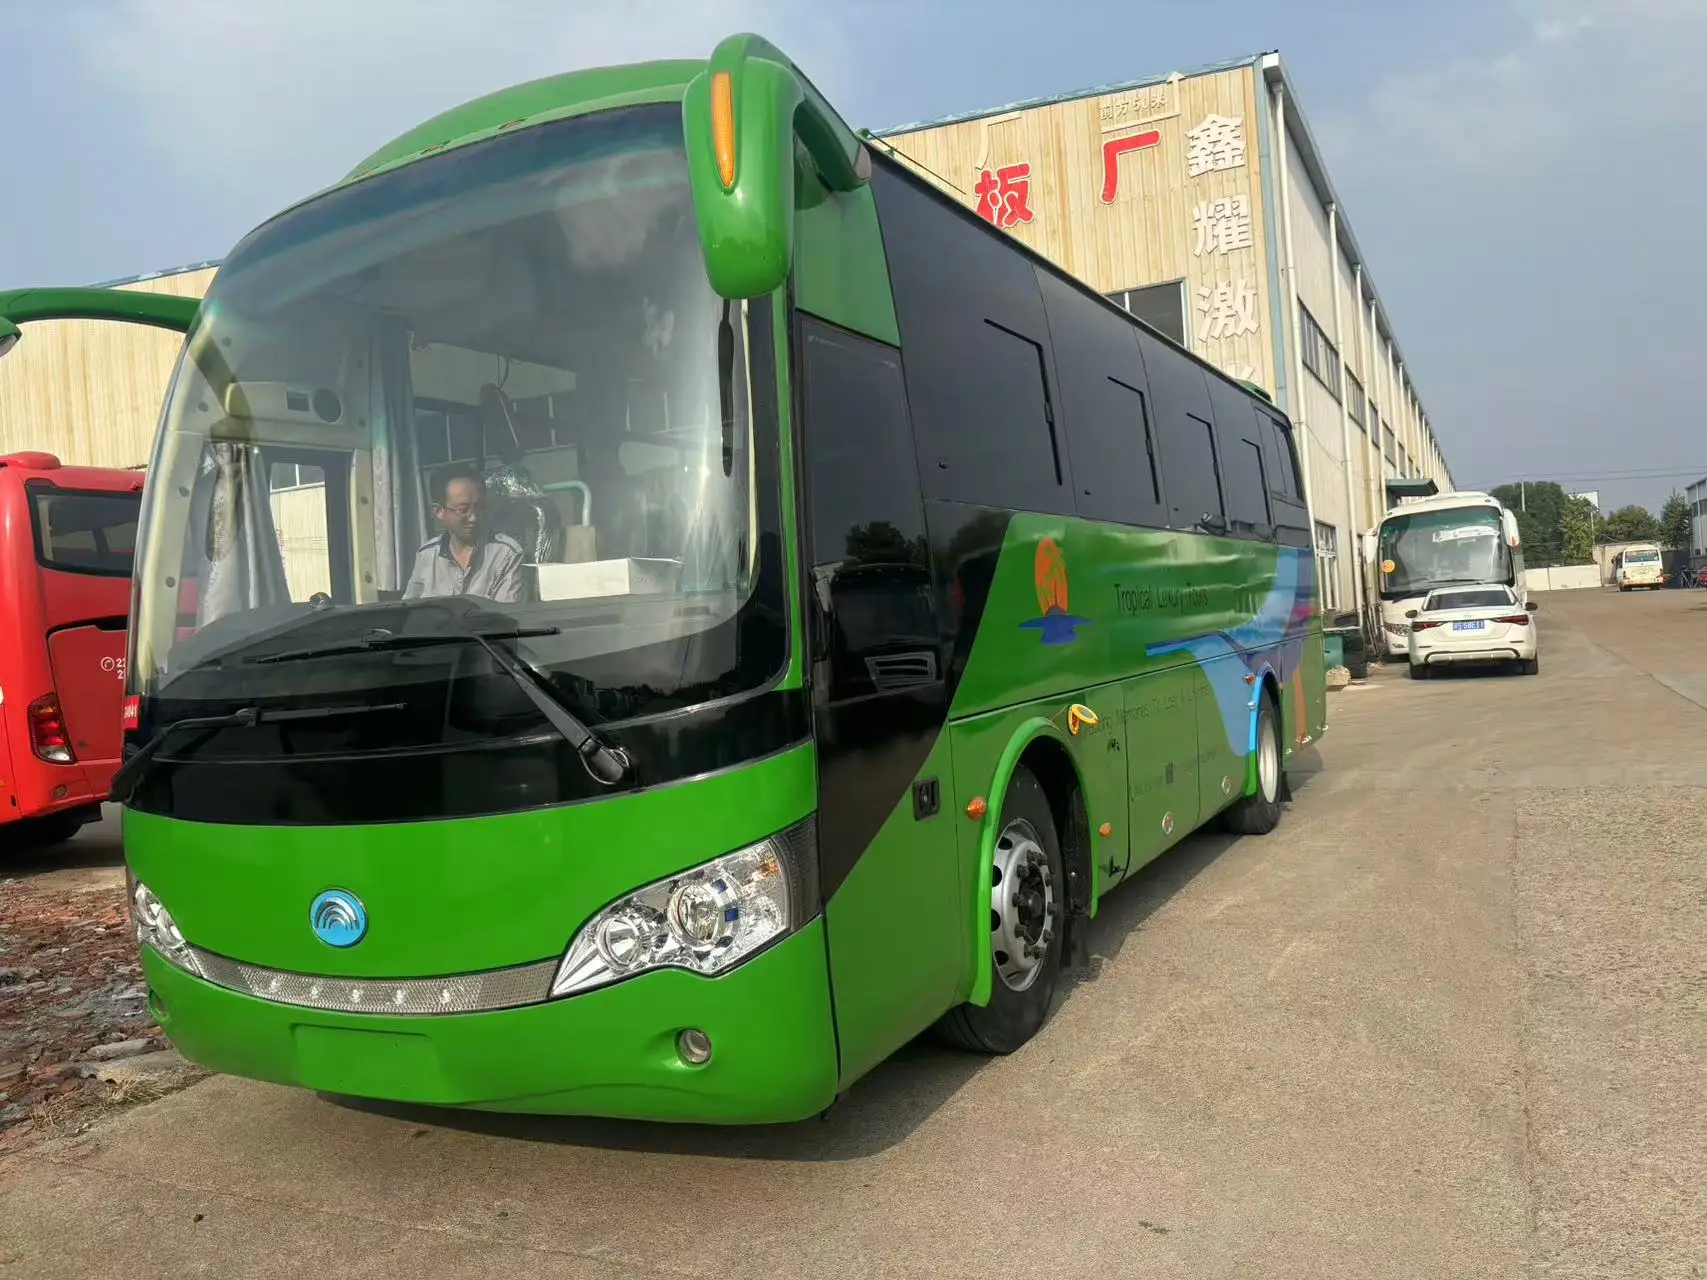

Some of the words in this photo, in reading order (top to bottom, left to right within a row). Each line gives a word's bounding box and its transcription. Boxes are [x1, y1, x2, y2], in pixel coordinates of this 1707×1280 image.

[1185, 112, 1260, 380] 鑫耀激
[1113, 583, 1150, 617] Tropical
[1155, 583, 1183, 615] Luxury
